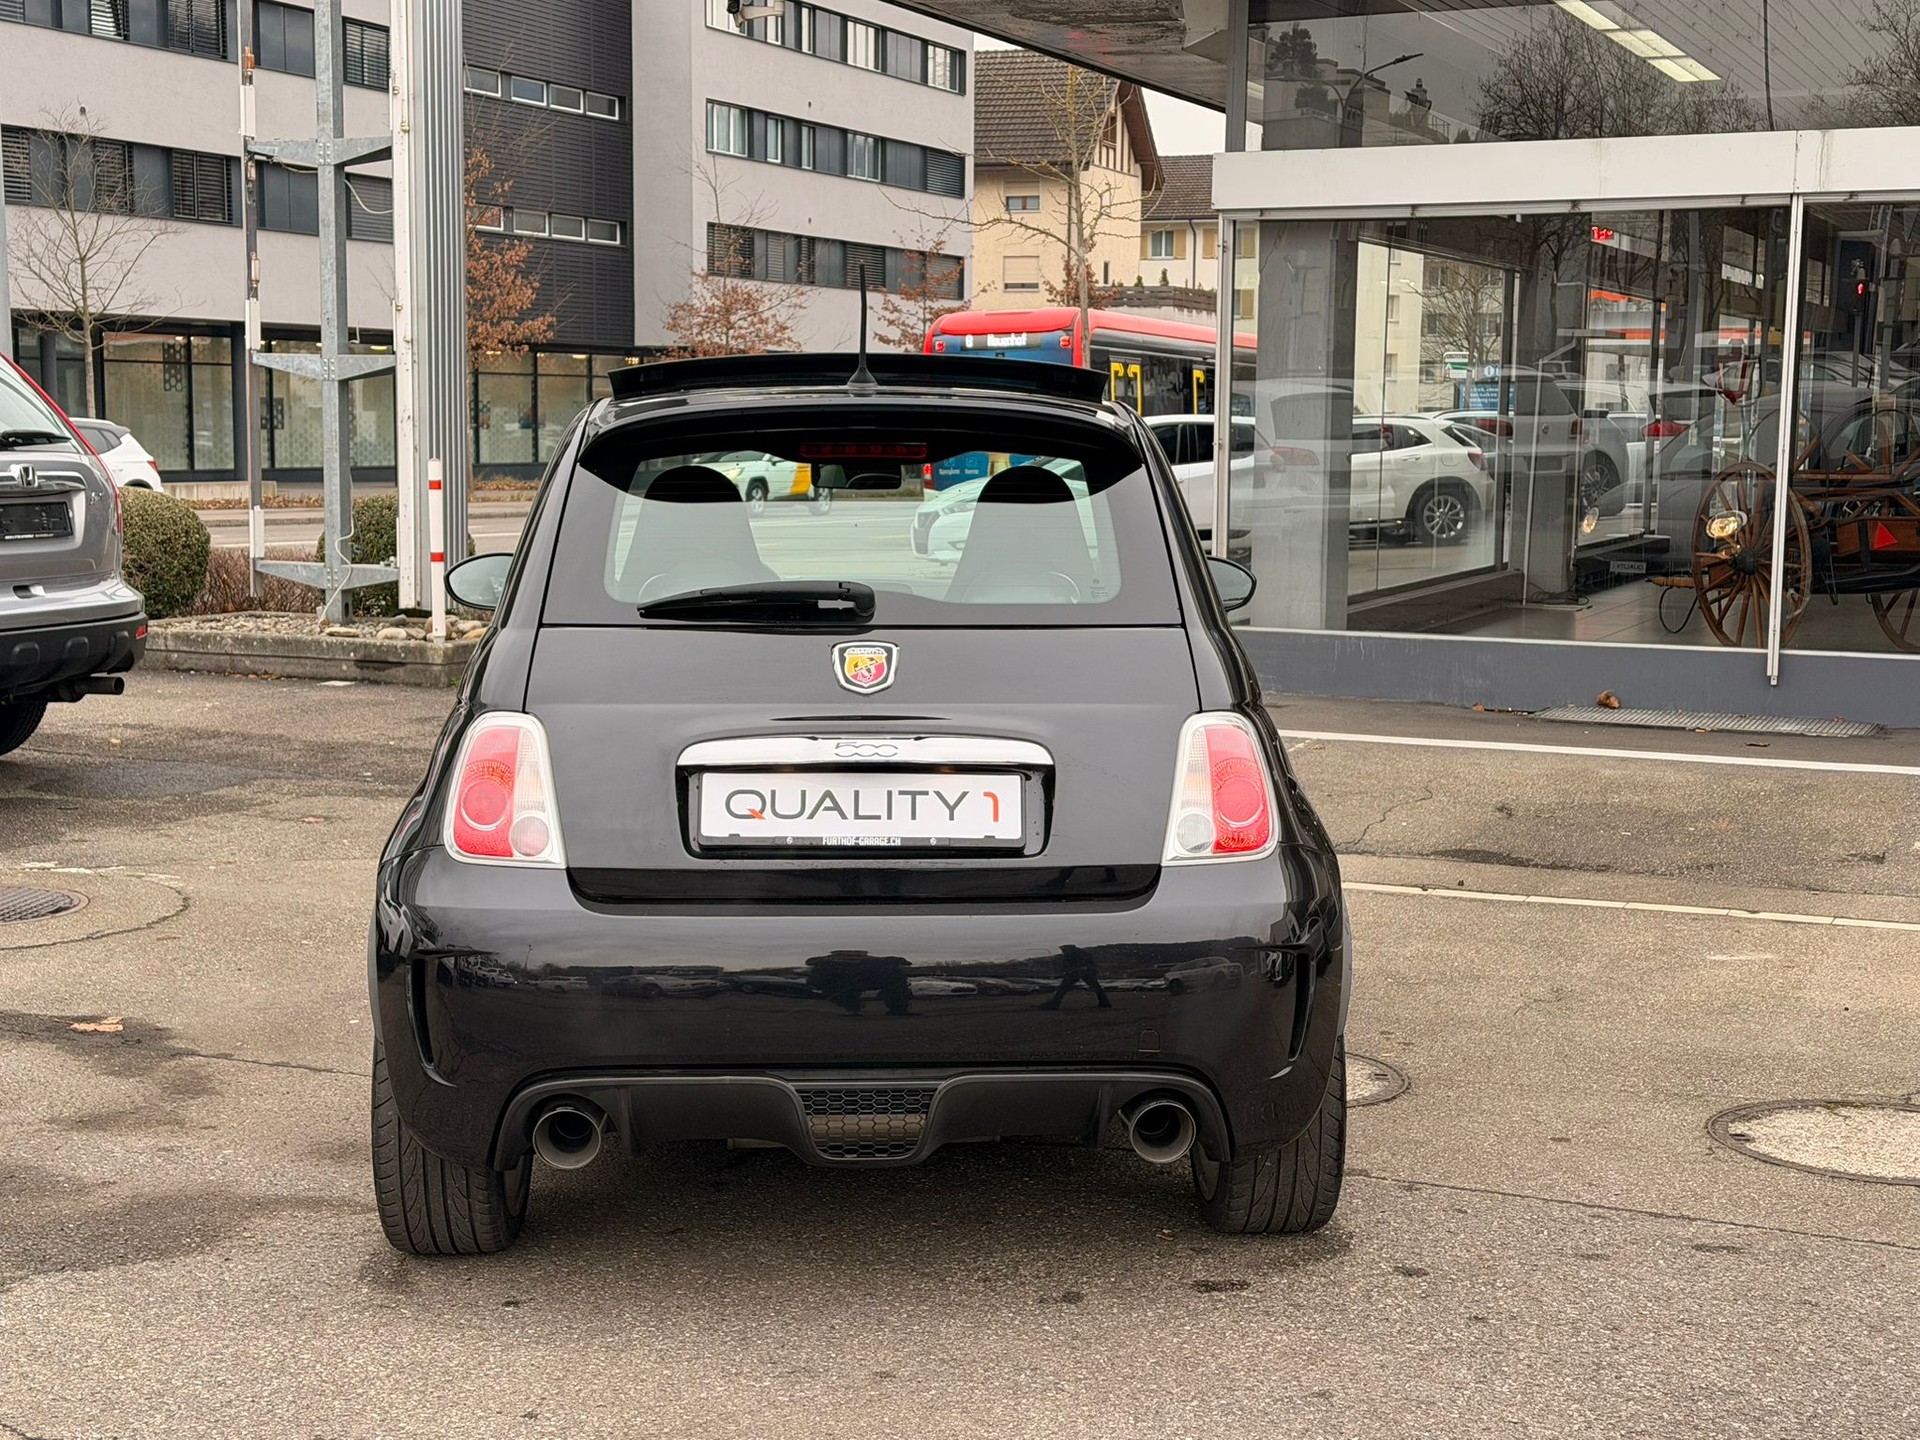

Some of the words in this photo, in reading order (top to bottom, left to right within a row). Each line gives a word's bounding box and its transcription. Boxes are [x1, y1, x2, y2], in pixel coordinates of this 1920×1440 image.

[833, 741, 899, 758] 500
[724, 788, 970, 822] QUALITY
[983, 790, 1000, 823] 1
[822, 836, 901, 846] FURTHOF-GARAGE.CH
